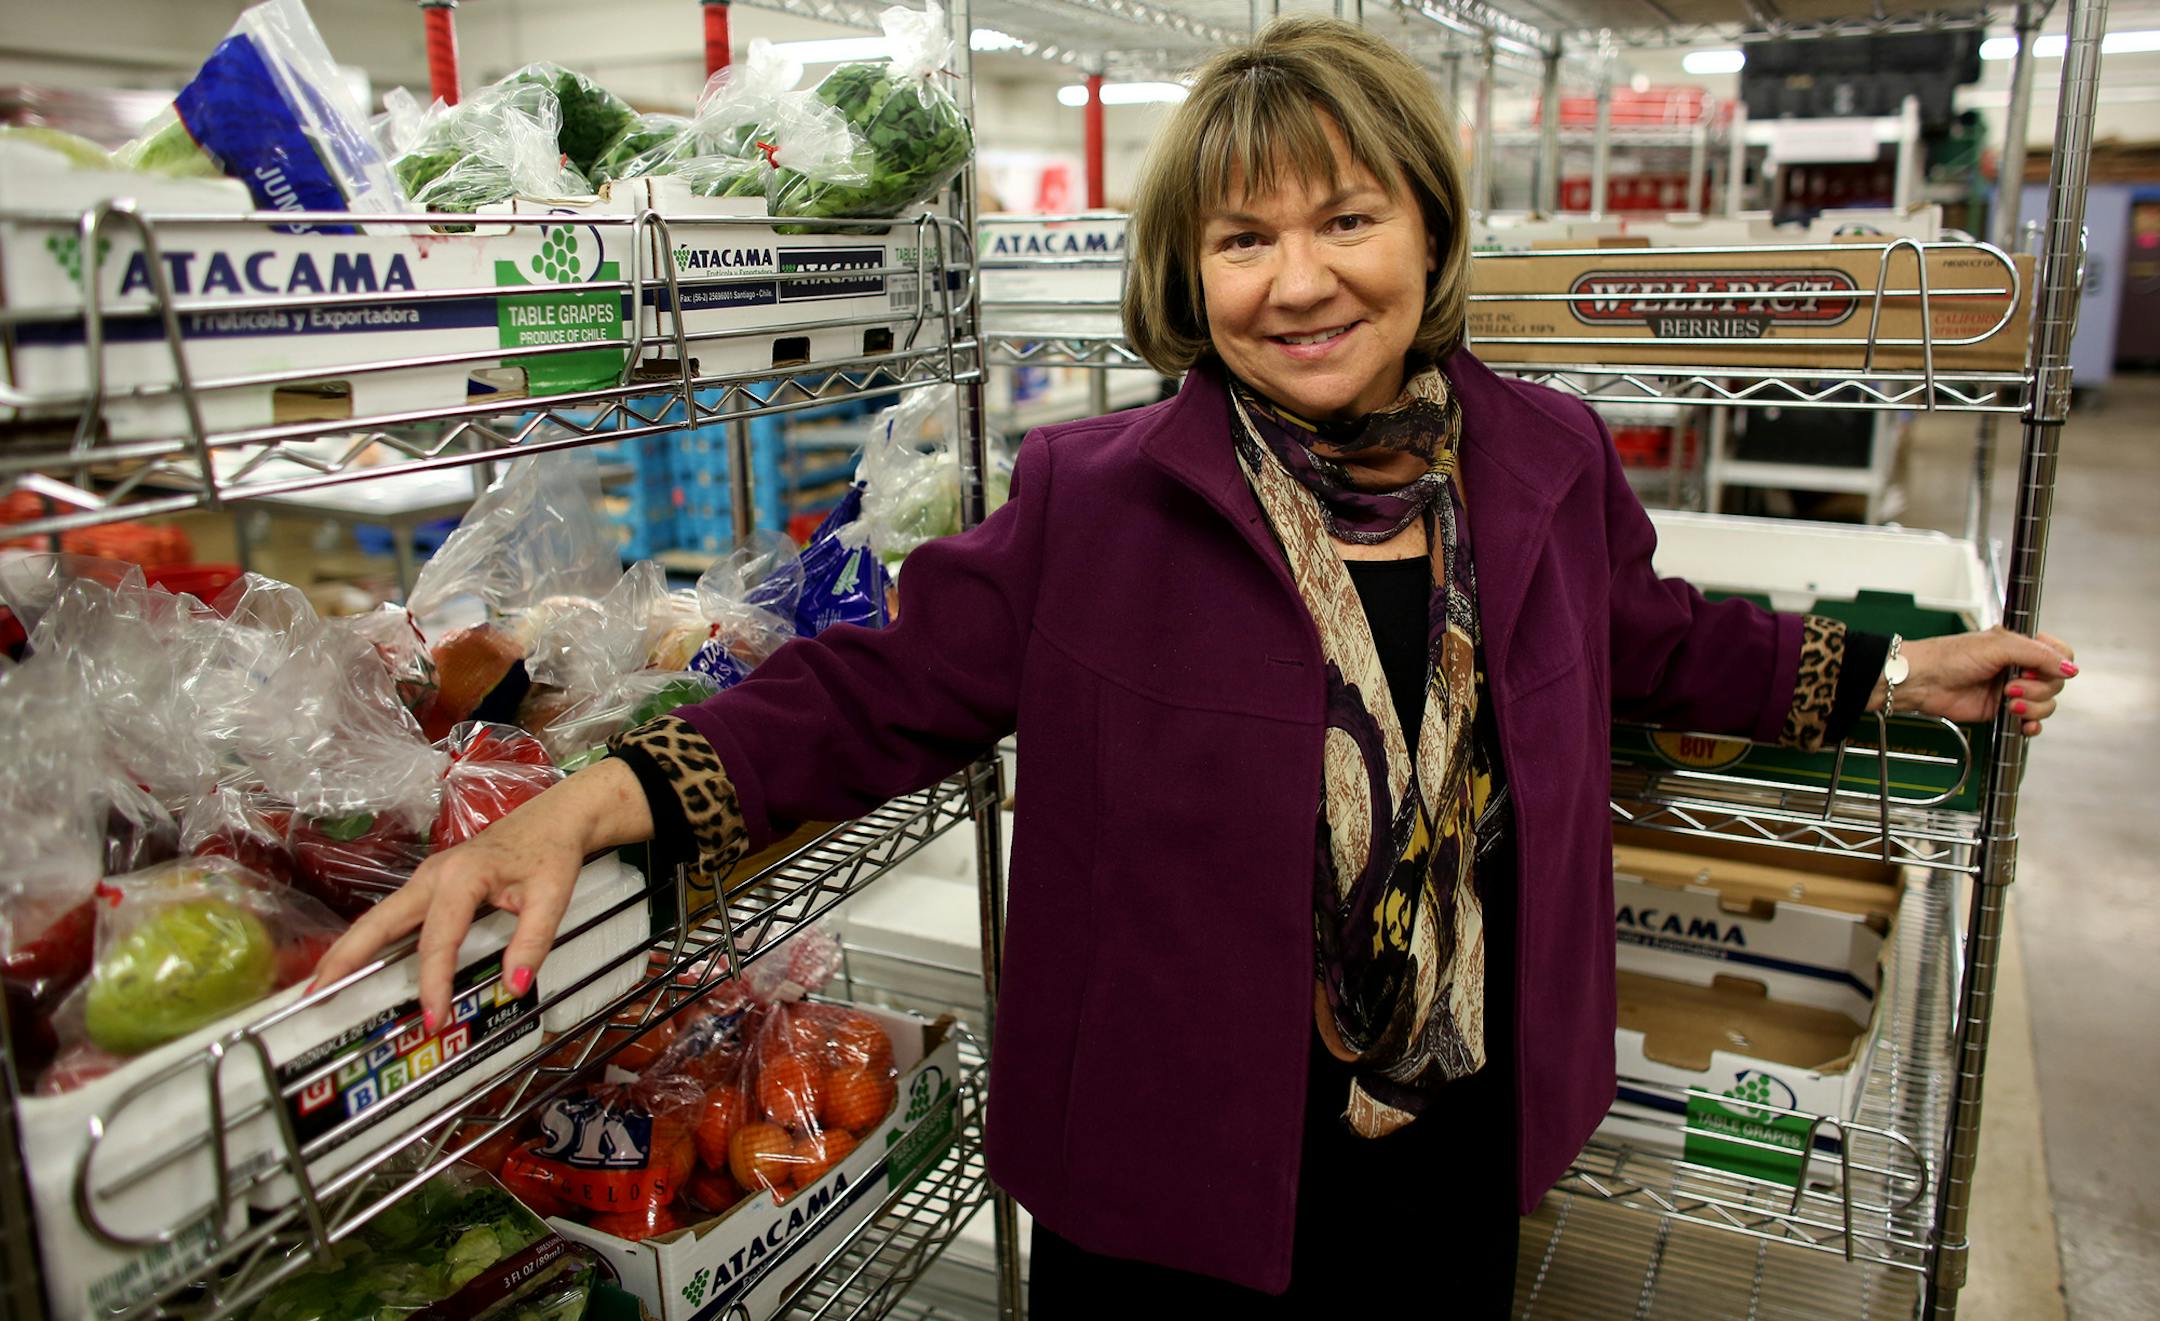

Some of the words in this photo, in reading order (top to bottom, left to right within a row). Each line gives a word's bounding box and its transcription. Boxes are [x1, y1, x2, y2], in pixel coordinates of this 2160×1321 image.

[688, 248, 773, 268] ATACAMA
[120, 251, 416, 296] ATACAMA
[311, 306, 420, 330] Exportadora
[508, 304, 556, 326] TABLE
[559, 303, 615, 325] GRAPES
[1660, 317, 1761, 338] BERRIES
[520, 329, 566, 345] PRODUCE
[567, 328, 580, 343] OF
[581, 327, 607, 342] CHILE
[1680, 734, 1719, 760] BOY
[486, 1002, 520, 1029] TABLE
[353, 1032, 466, 1112] BEST
[513, 1160, 667, 1202] TGELOS
[710, 1172, 850, 1296] ATACAMA
[503, 1276, 511, 1289] 3
[522, 1261, 535, 1277] OZ
